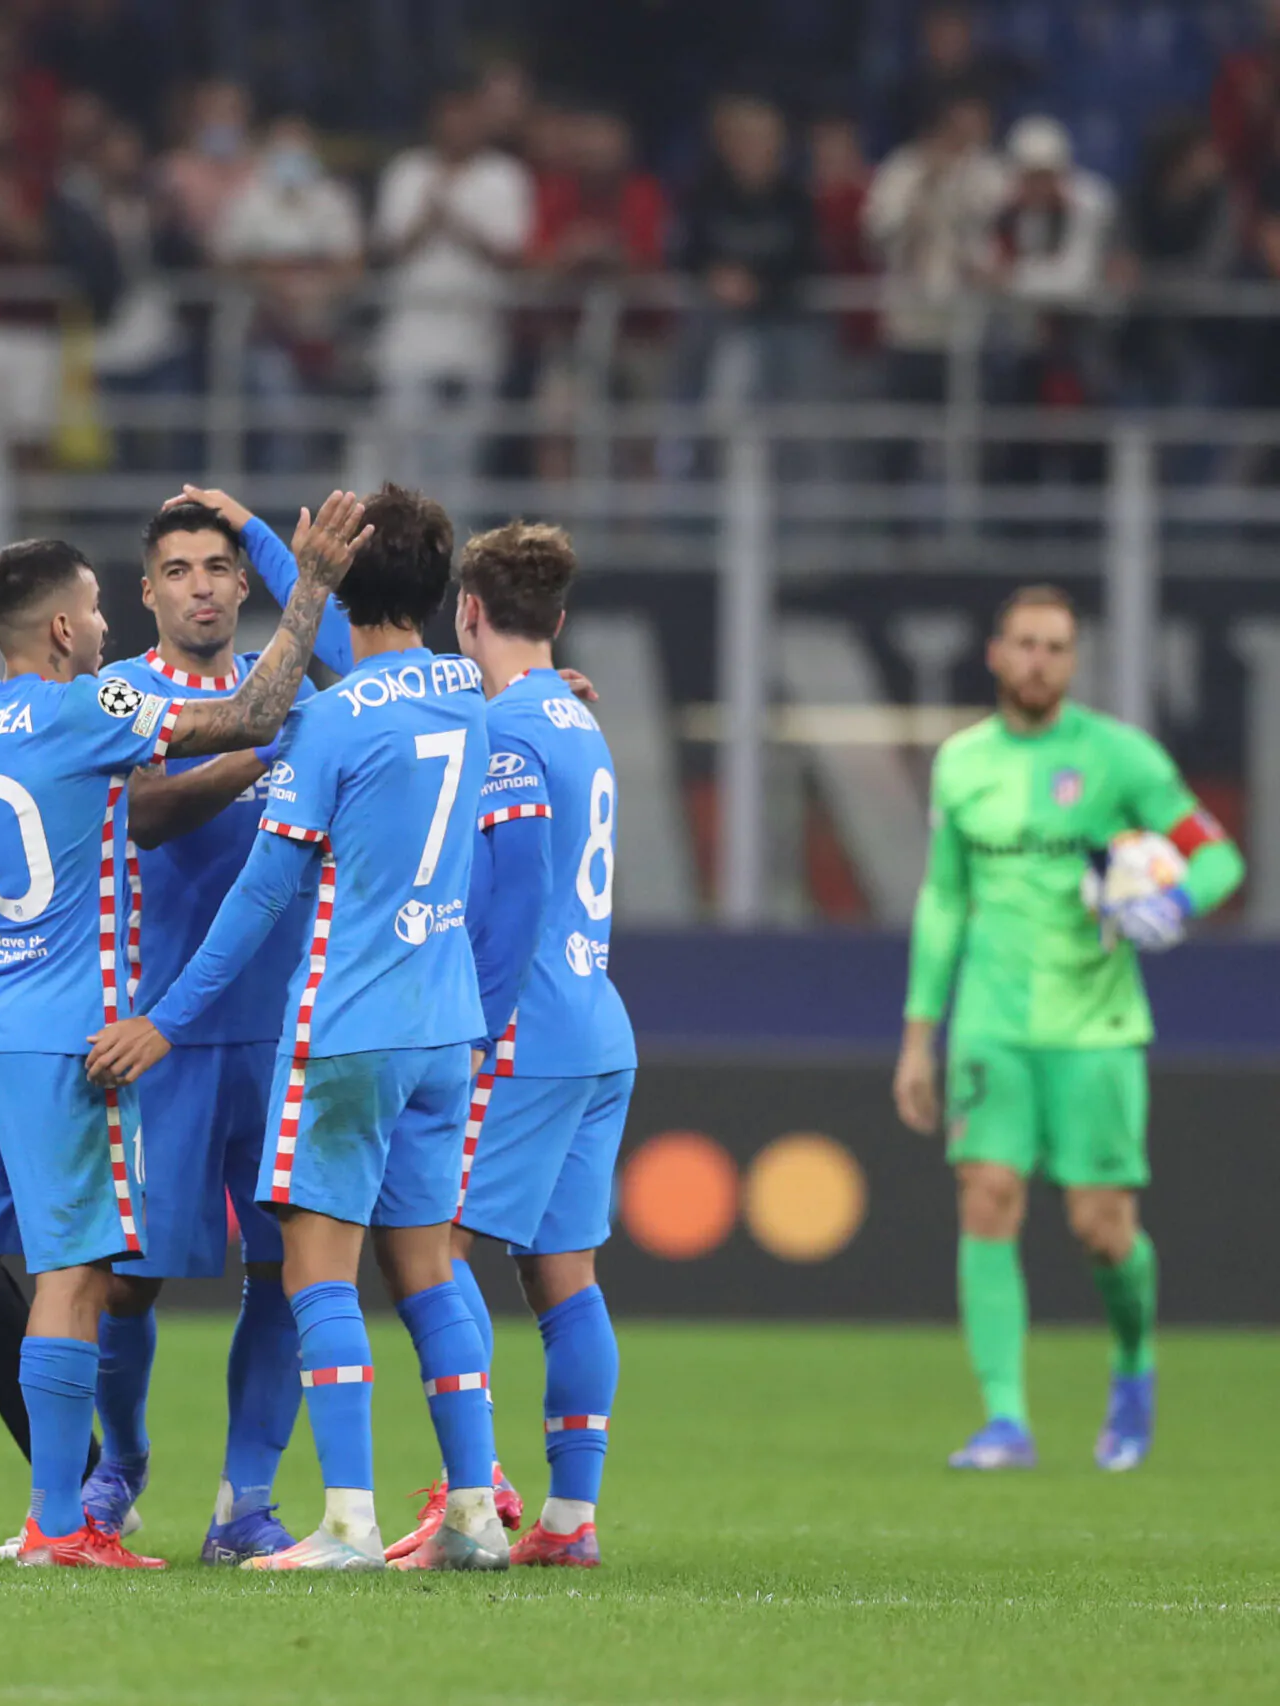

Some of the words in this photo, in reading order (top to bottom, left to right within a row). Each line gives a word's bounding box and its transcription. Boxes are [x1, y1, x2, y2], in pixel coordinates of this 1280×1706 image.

[337, 667, 426, 717] JOÃO
[414, 729, 467, 887] 7
[481, 775, 539, 797] HYUNDAI
[575, 767, 614, 920] 8
